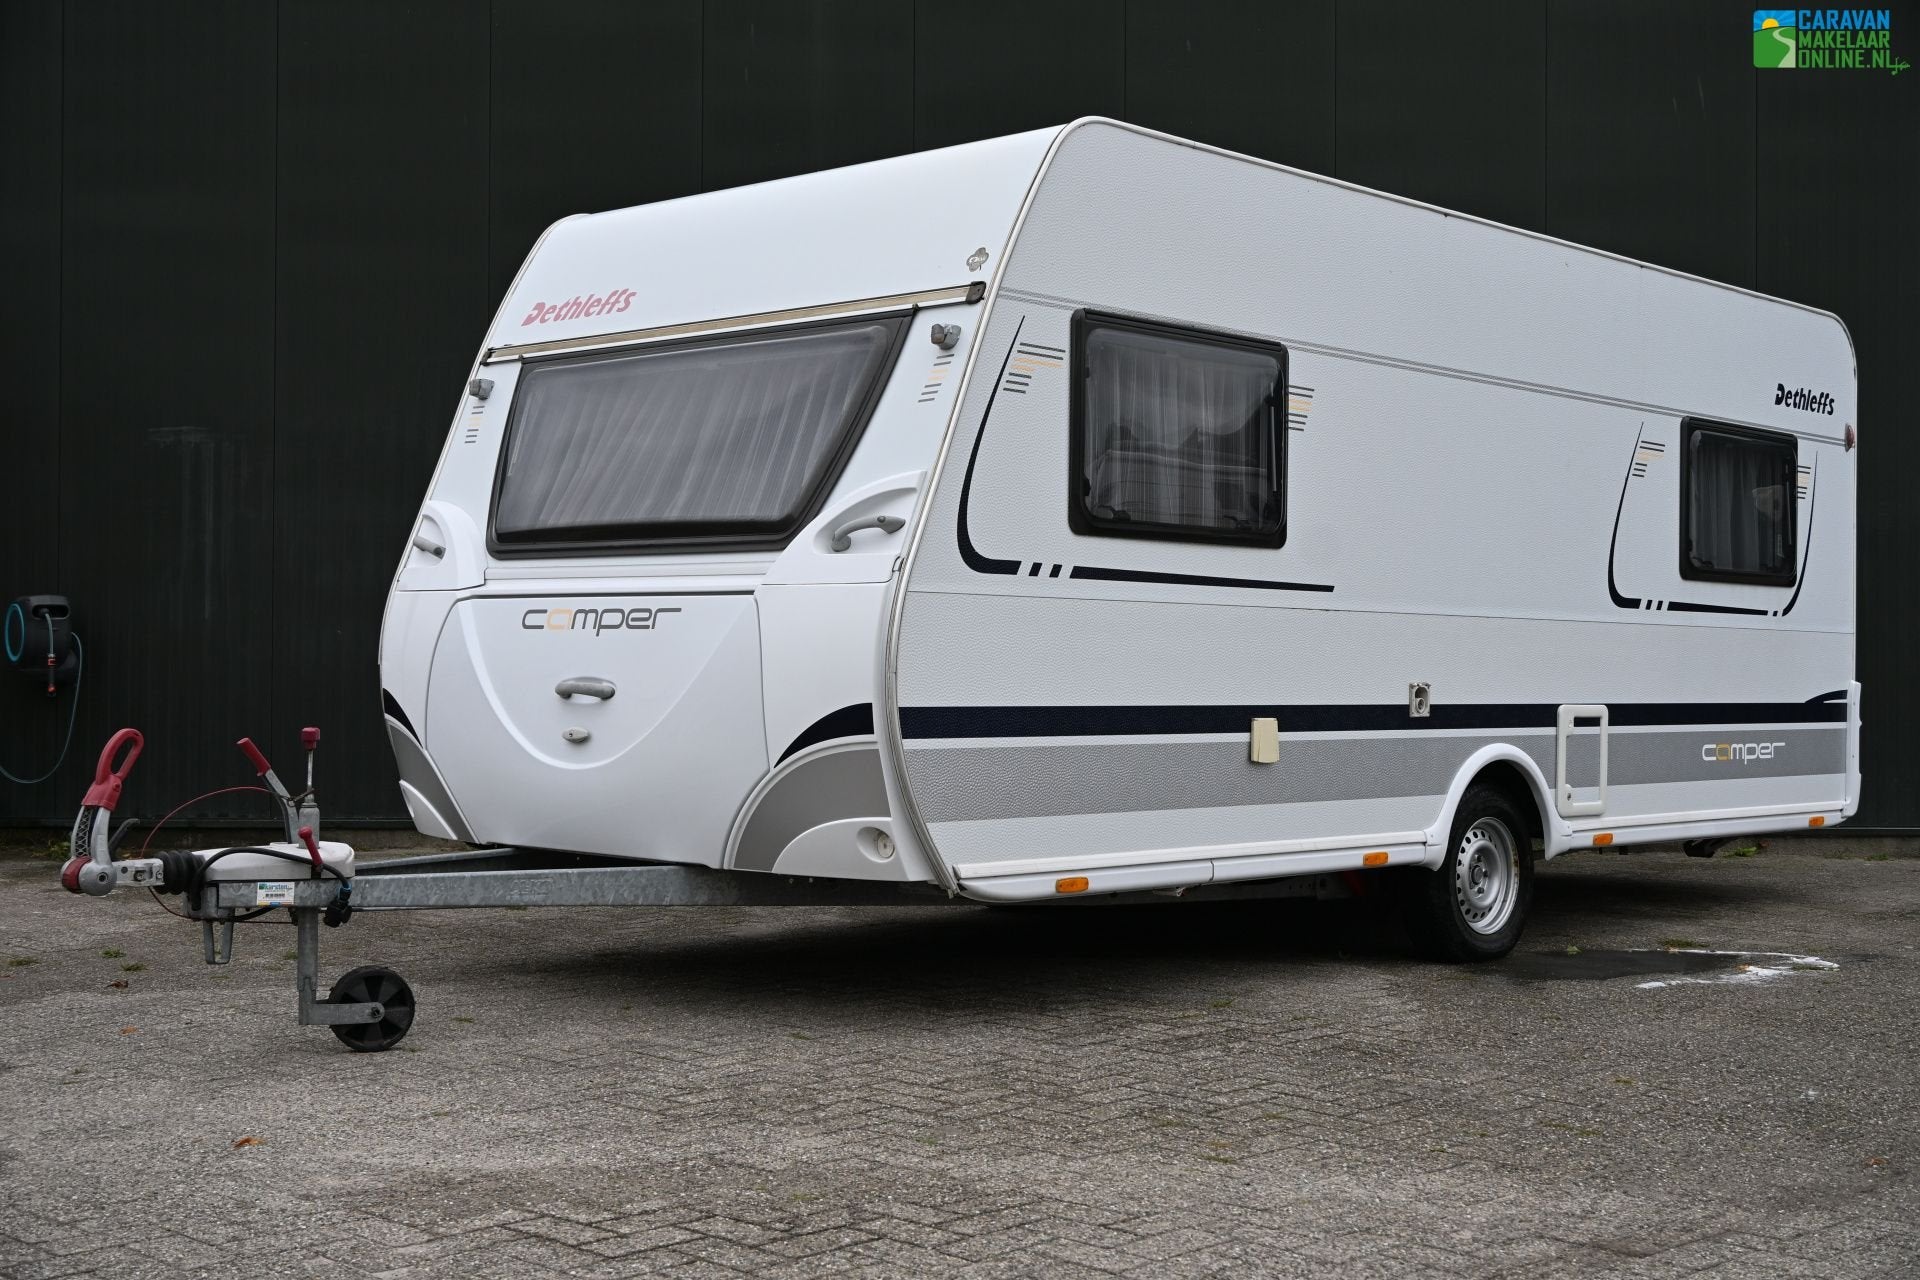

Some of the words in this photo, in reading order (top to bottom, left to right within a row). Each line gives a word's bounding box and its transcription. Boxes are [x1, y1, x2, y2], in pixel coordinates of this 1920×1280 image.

[521, 288, 637, 327] Dethleffs
[1774, 382, 1835, 416] Dethleffs
[521, 607, 682, 637] camper
[1702, 742, 1786, 765] camper
